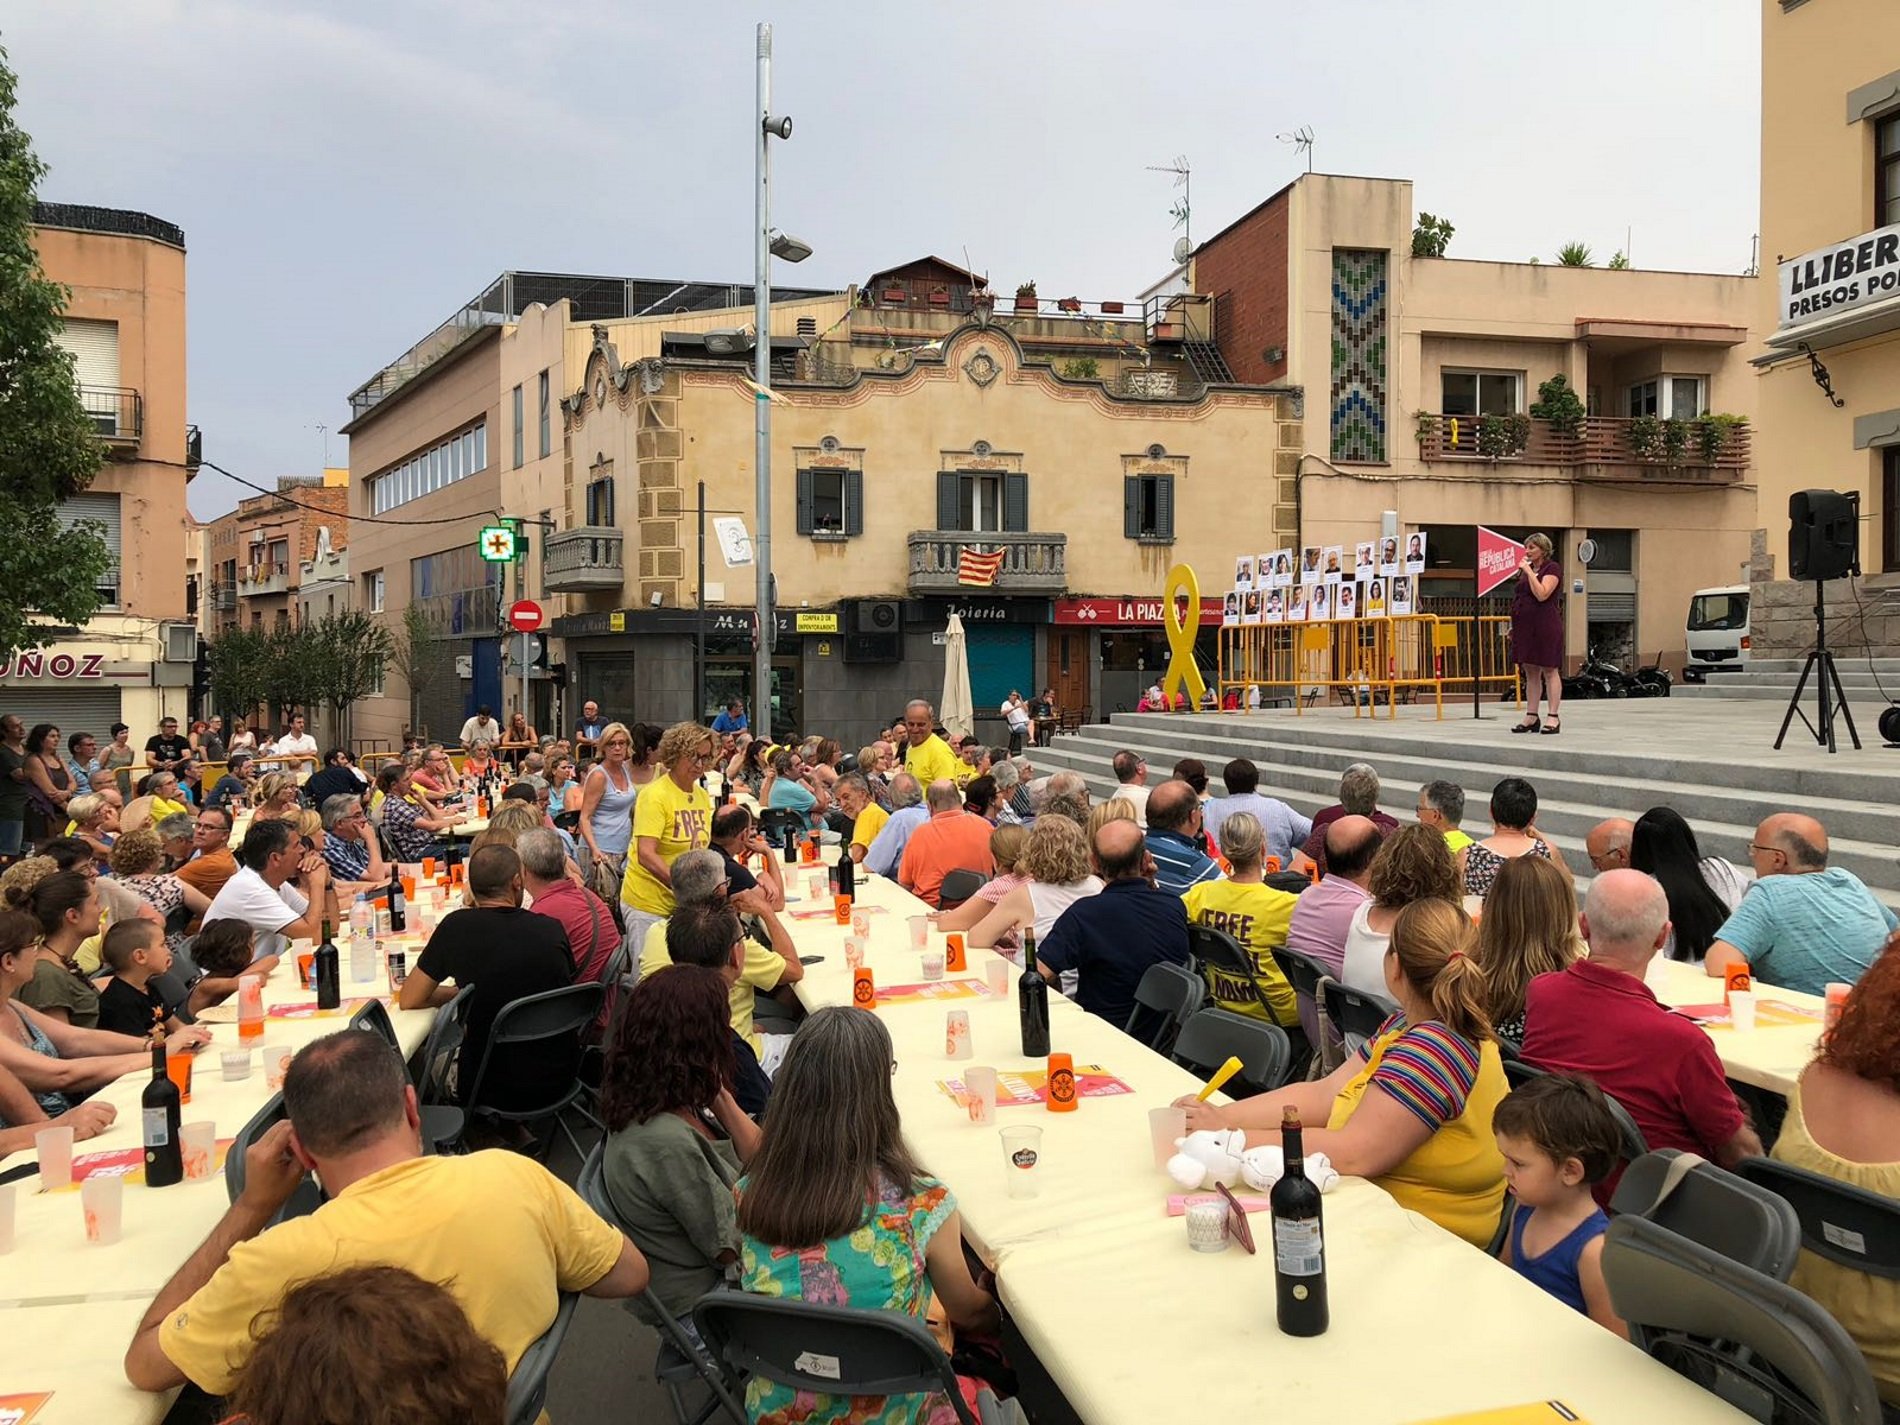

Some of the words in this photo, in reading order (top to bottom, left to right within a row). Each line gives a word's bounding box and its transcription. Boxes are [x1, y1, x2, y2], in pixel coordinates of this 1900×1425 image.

[1791, 234, 1899, 295] LLIBER
[1789, 282, 1860, 319] PRESOS
[1868, 270, 1900, 296] PO
[1118, 603, 1134, 621] LA
[1137, 603, 1181, 621] PIAZA
[672, 809, 706, 838] FREE
